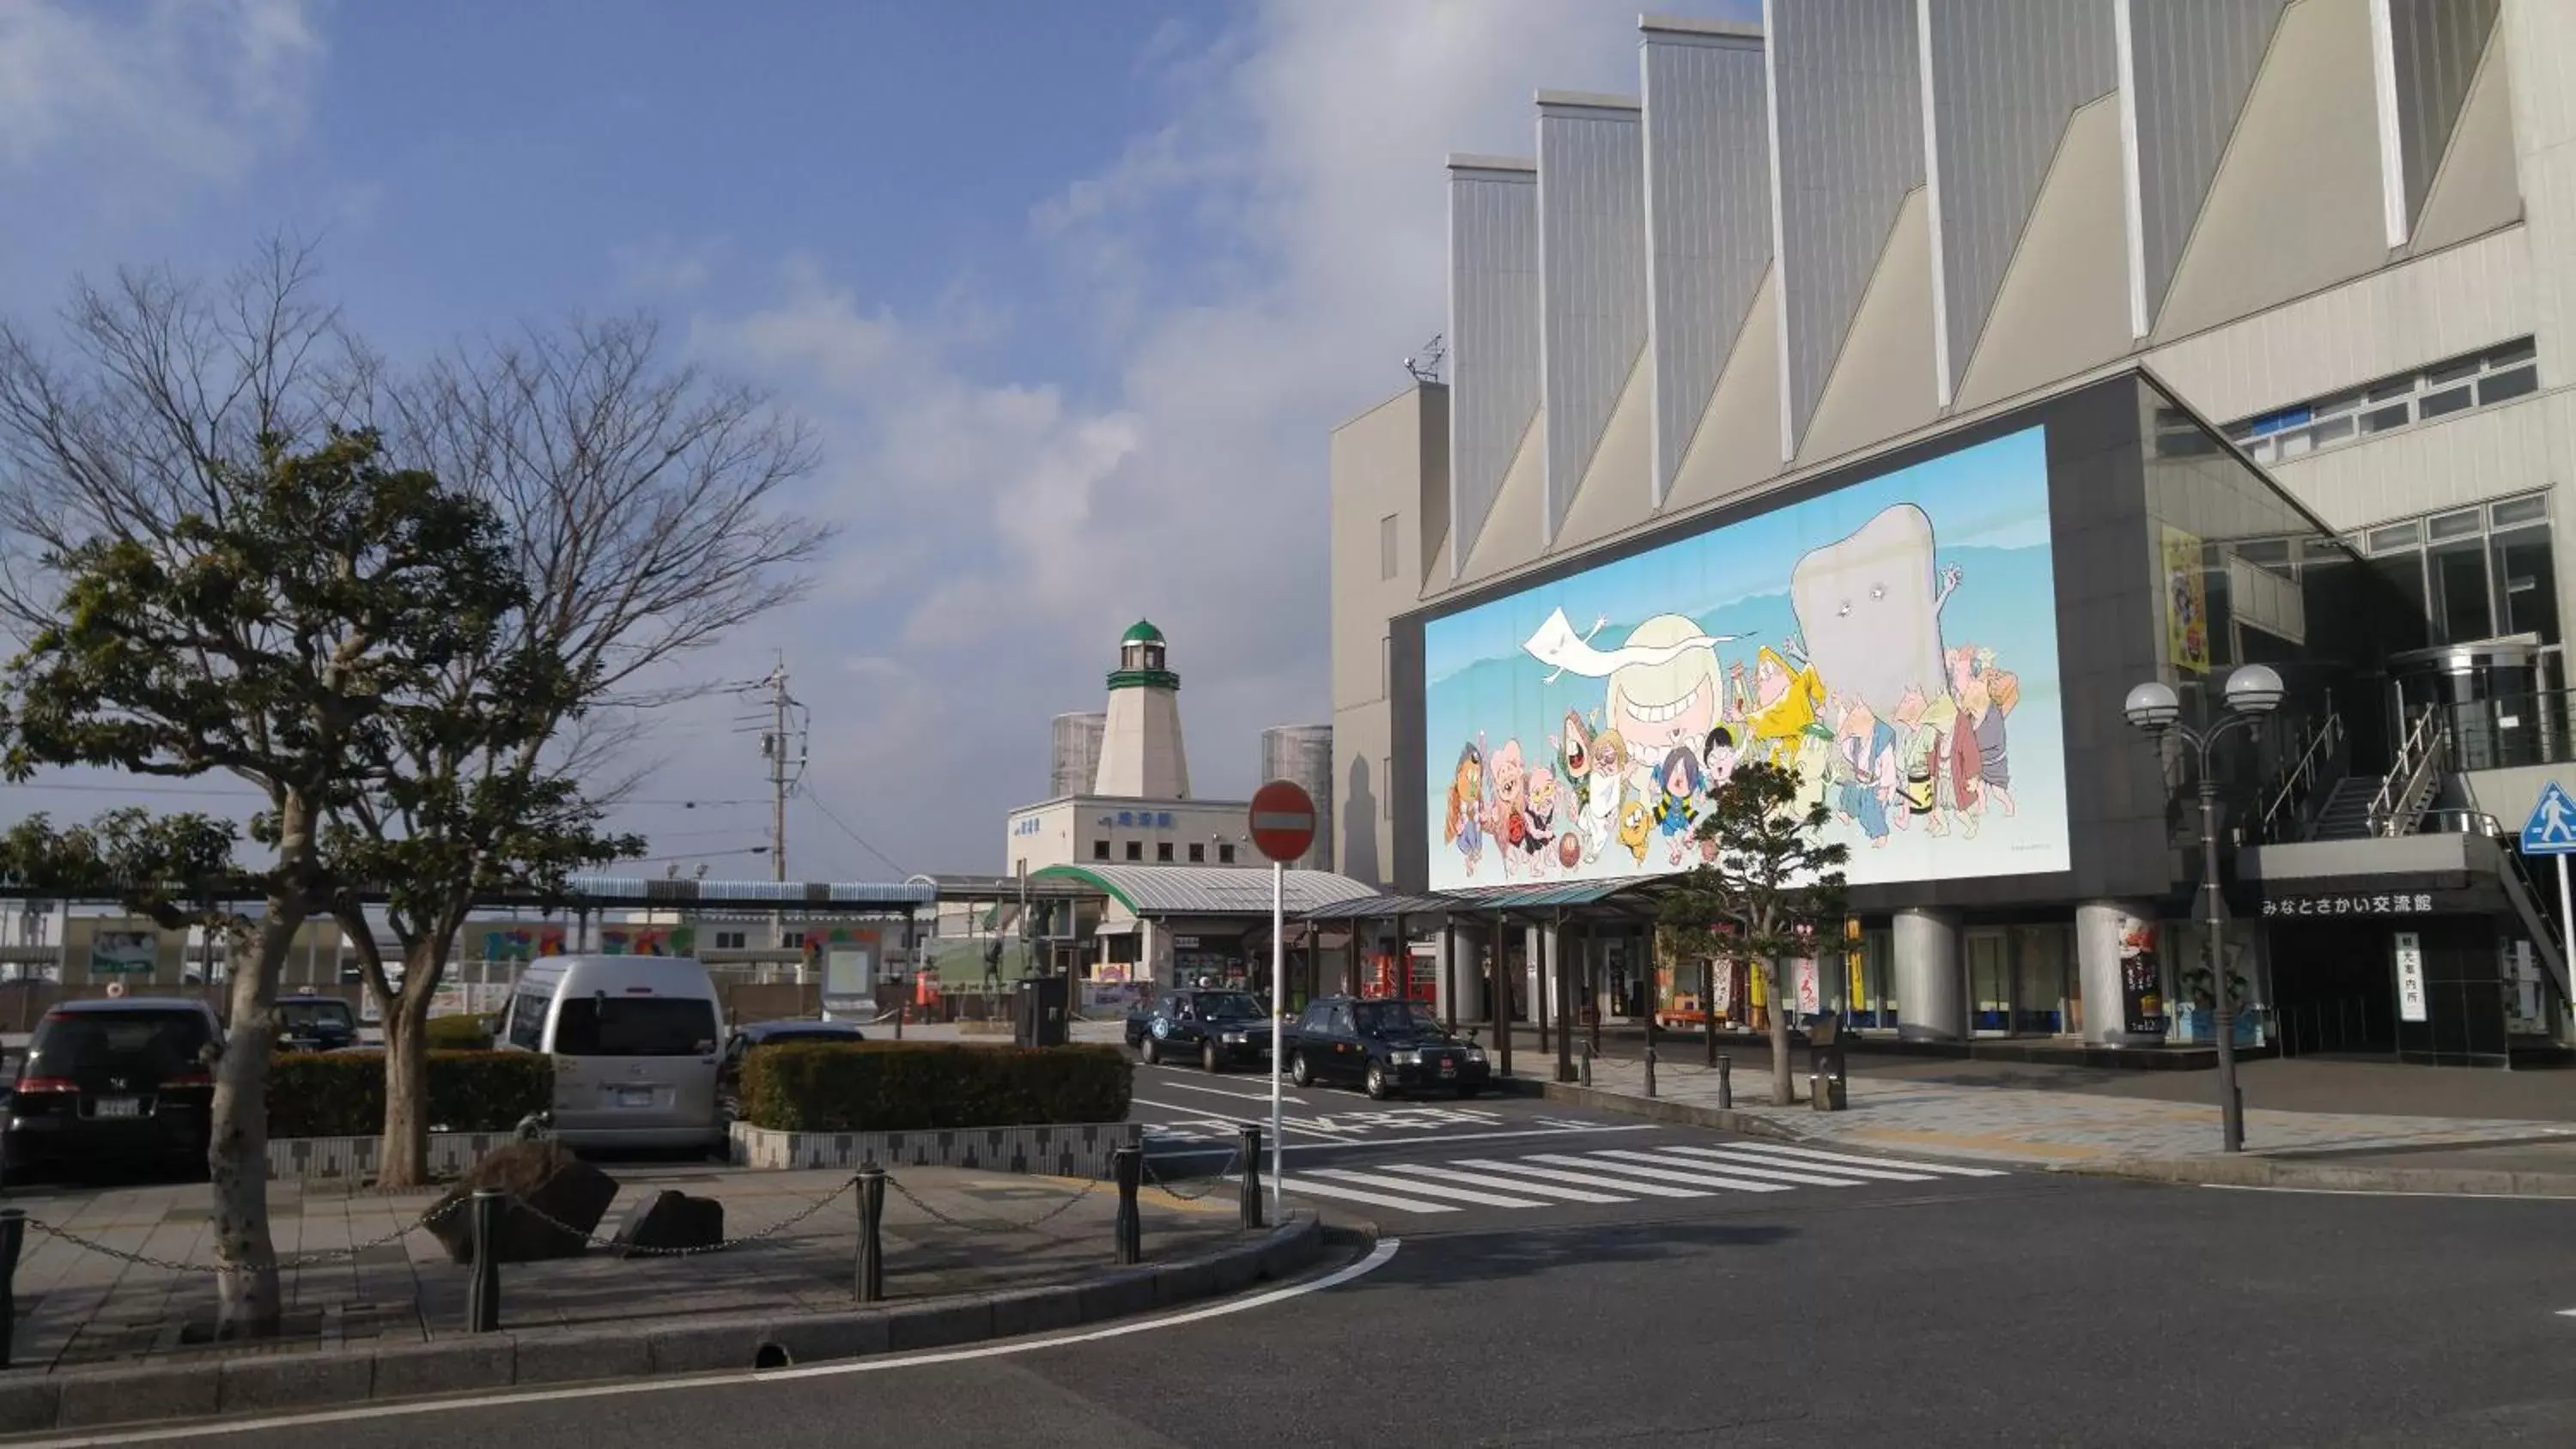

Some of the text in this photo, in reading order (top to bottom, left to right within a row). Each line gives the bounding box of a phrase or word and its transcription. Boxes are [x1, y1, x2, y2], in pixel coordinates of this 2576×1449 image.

[2262, 894, 2432, 916] みなとさかい交流館
